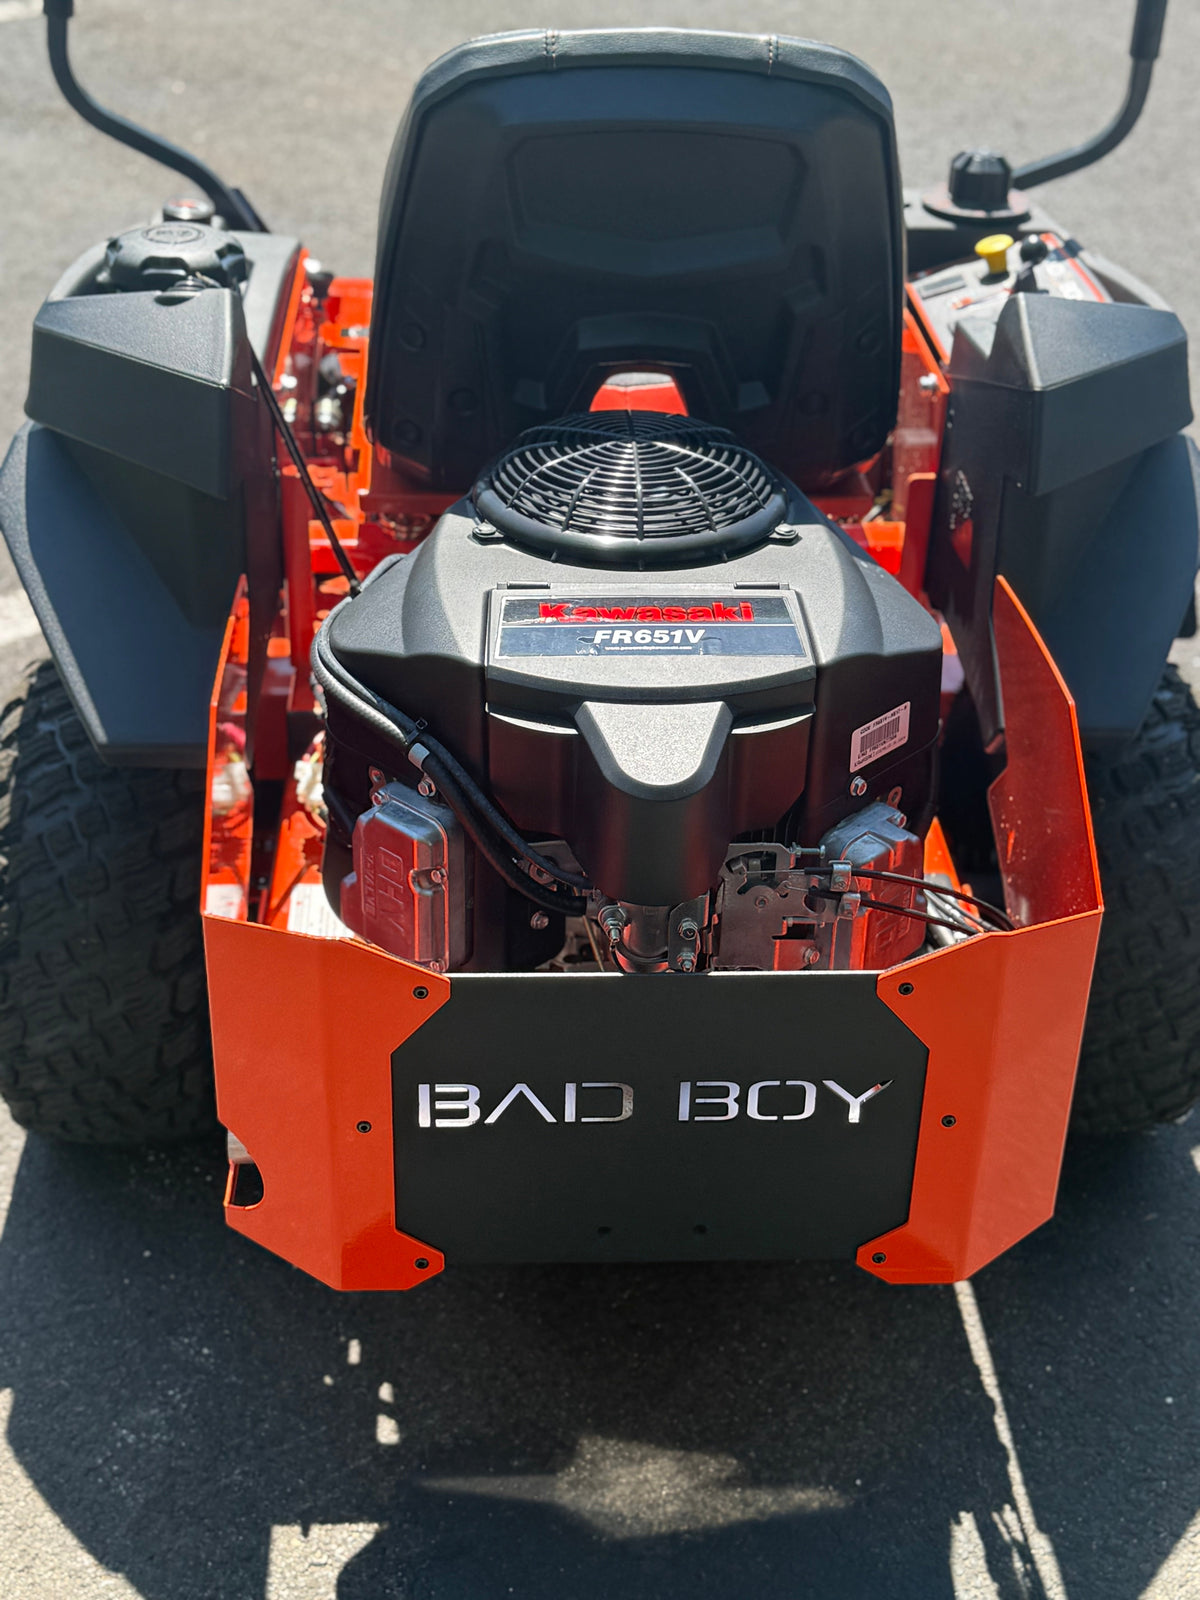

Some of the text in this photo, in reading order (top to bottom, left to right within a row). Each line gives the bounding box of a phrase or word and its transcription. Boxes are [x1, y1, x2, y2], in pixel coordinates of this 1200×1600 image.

[538, 602, 755, 623] Kawasaki
[593, 629, 706, 645] FR651V
[378, 846, 405, 936] OHV
[417, 1079, 895, 1128] BAD BOY
